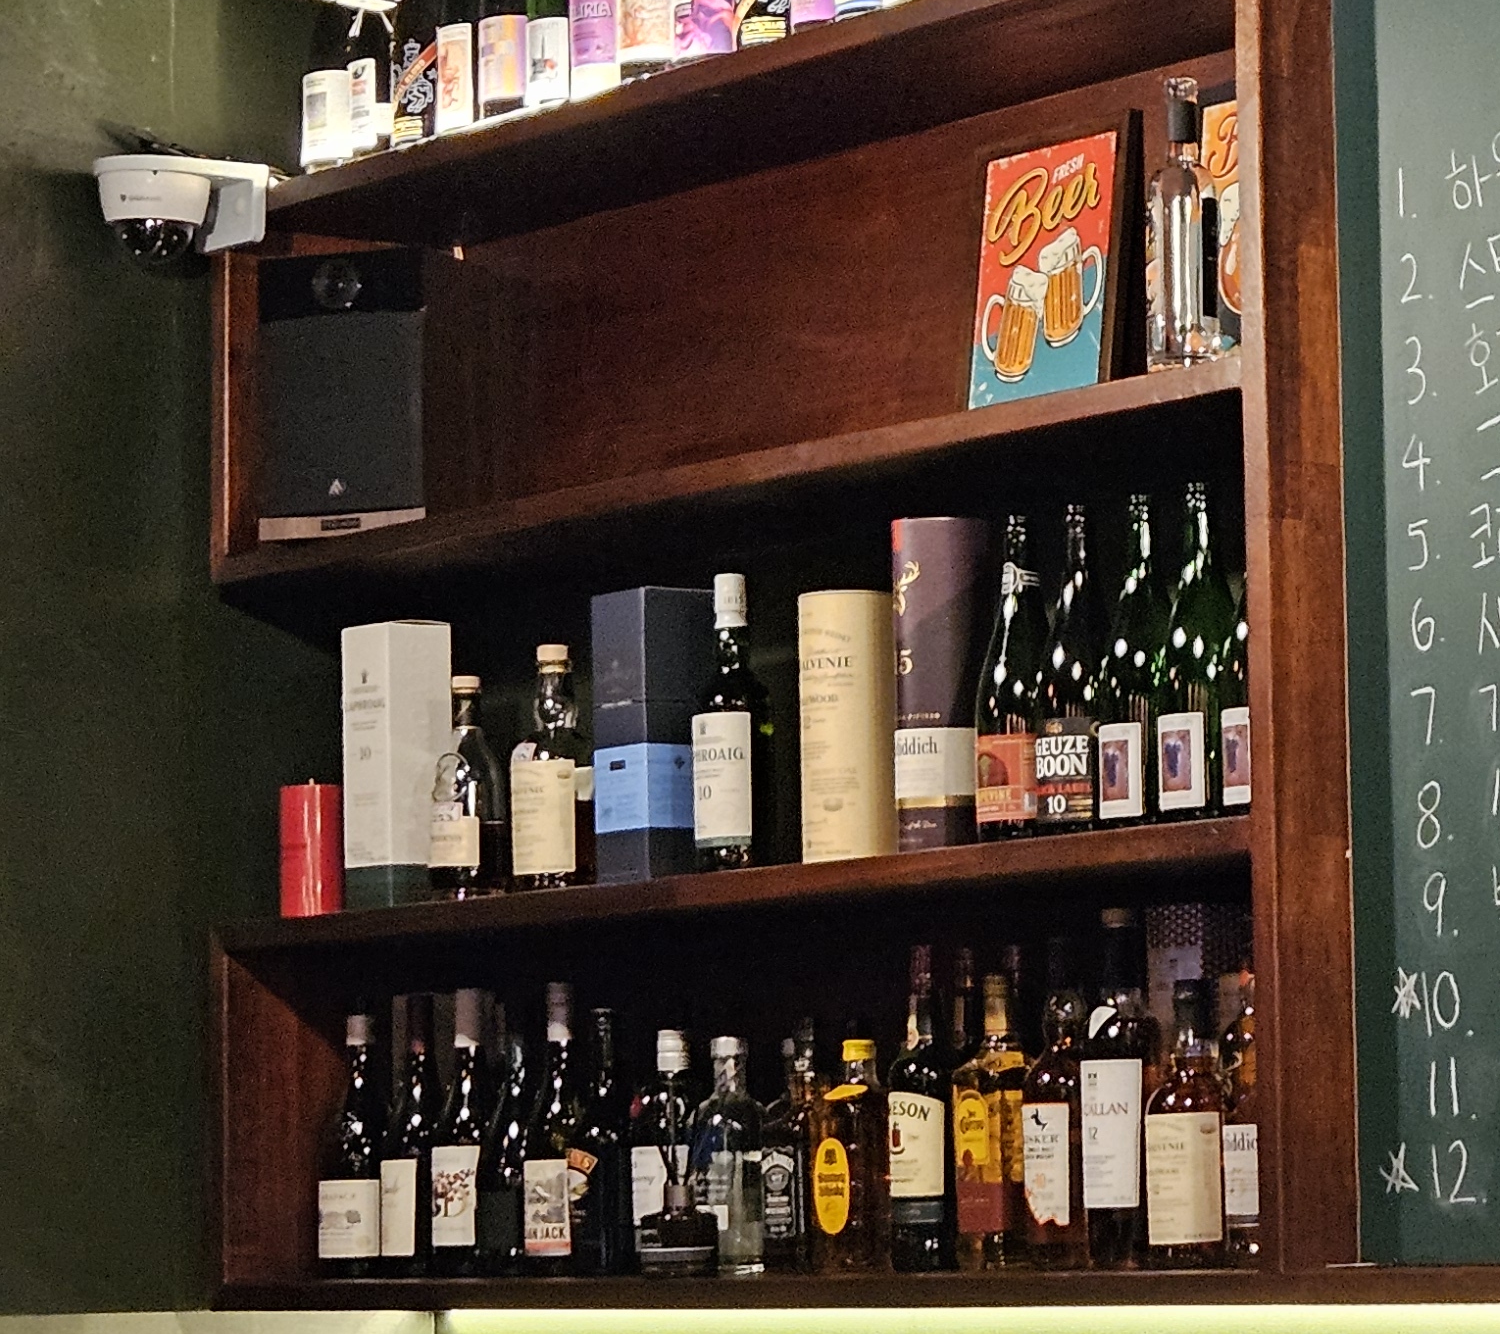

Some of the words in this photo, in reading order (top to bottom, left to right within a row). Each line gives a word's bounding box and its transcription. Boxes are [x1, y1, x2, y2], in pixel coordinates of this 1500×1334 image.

[987, 163, 1101, 266] Beer
[1036, 735, 1090, 755] GEUZE
[1036, 754, 1089, 778] BOON
[1047, 794, 1066, 814] 10
[890, 1101, 931, 1122] ESON
